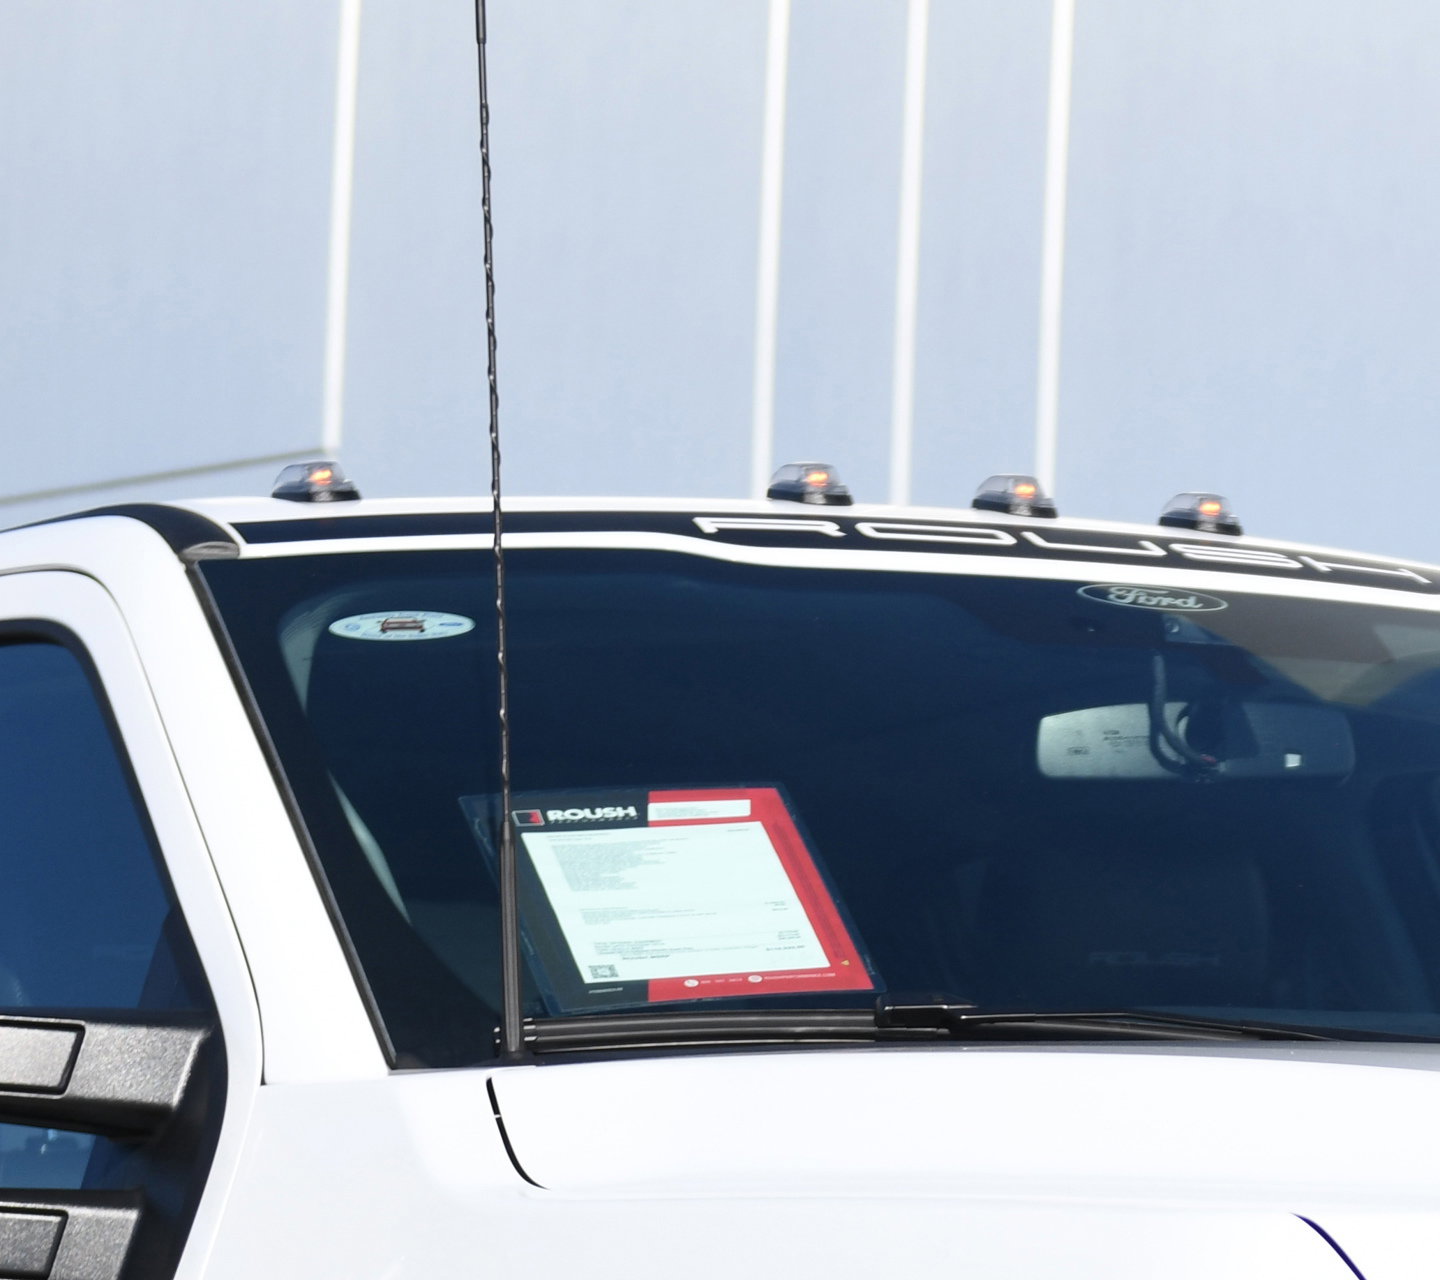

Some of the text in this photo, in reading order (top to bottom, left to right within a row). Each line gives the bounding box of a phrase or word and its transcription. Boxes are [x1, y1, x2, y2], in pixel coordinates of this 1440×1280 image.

[691, 516, 1433, 585] ROUSH
[1107, 586, 1204, 609] Ford
[546, 806, 638, 822] ROUSH
